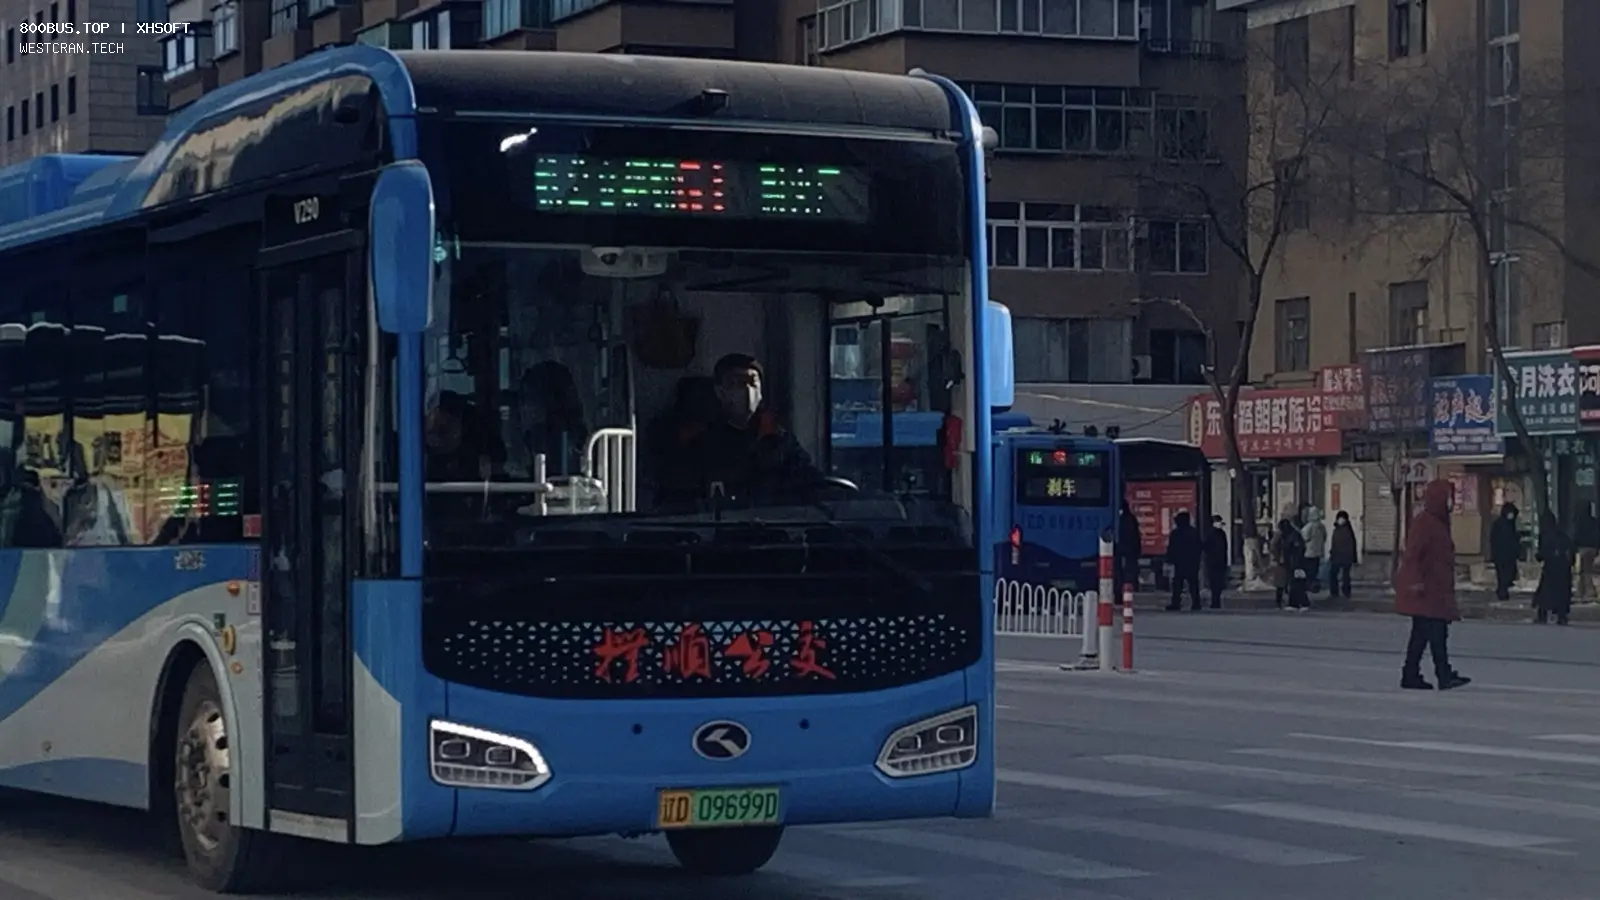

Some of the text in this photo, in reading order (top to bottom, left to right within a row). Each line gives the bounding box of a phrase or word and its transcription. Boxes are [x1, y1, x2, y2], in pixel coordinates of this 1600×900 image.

[1205, 395, 1339, 436] 东路朝鲜族冷
[698, 790, 779, 823] 09699D
